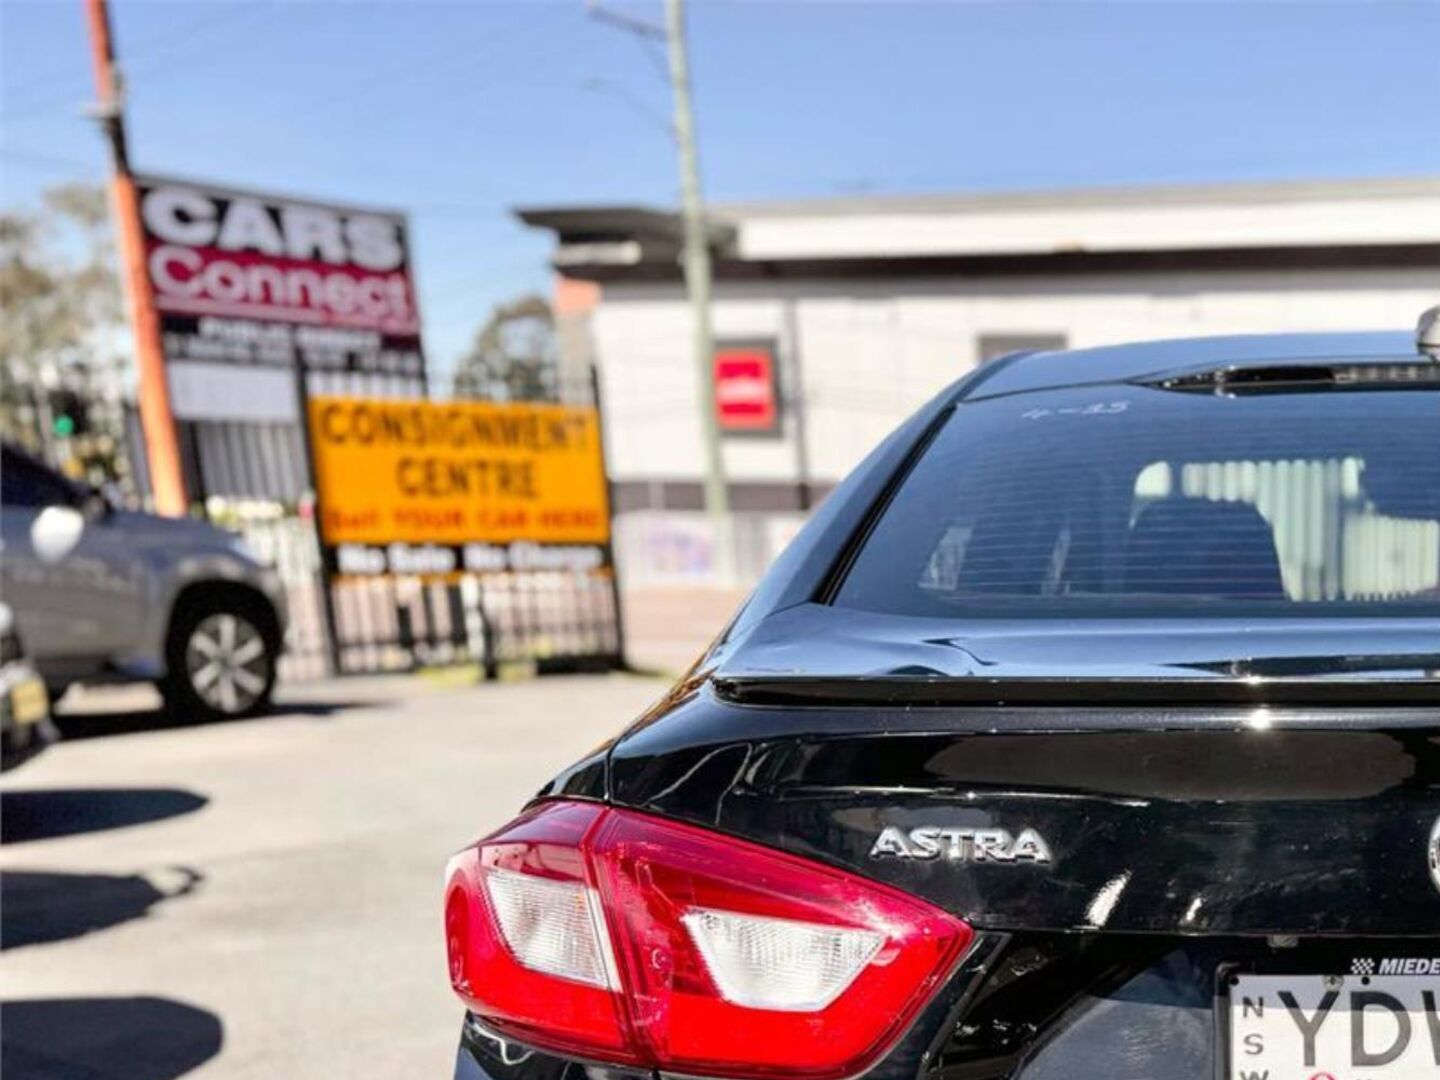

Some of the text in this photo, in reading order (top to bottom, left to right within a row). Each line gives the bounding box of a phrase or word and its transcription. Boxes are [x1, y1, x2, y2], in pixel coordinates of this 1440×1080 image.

[142, 185, 403, 272] CARS
[150, 244, 408, 319] Connect
[322, 404, 587, 450] CONSIGNMENT
[397, 458, 538, 499] CENTRE
[868, 824, 1051, 864] ASTRA
